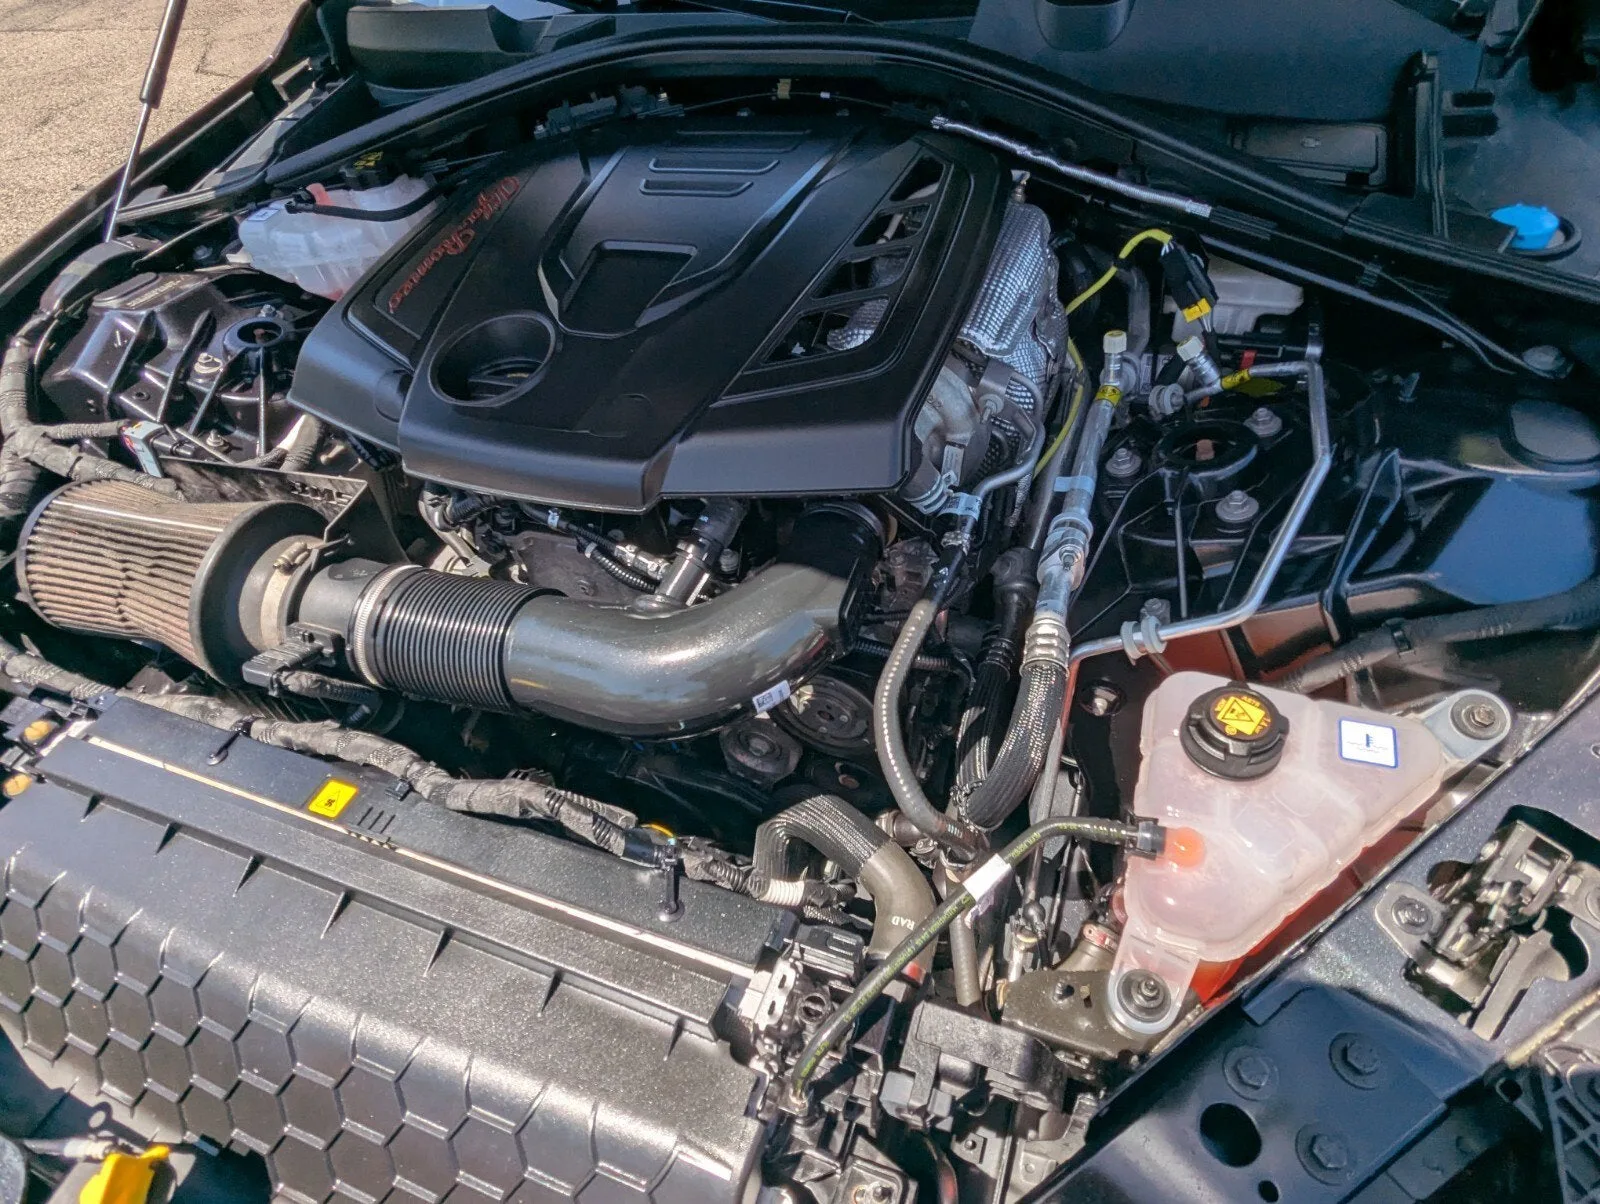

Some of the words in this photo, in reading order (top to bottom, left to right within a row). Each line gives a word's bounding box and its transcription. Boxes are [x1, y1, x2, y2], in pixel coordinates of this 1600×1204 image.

[464, 176, 520, 226] Alfa
[388, 228, 476, 314] Romeo
[891, 916, 915, 930] RAD
